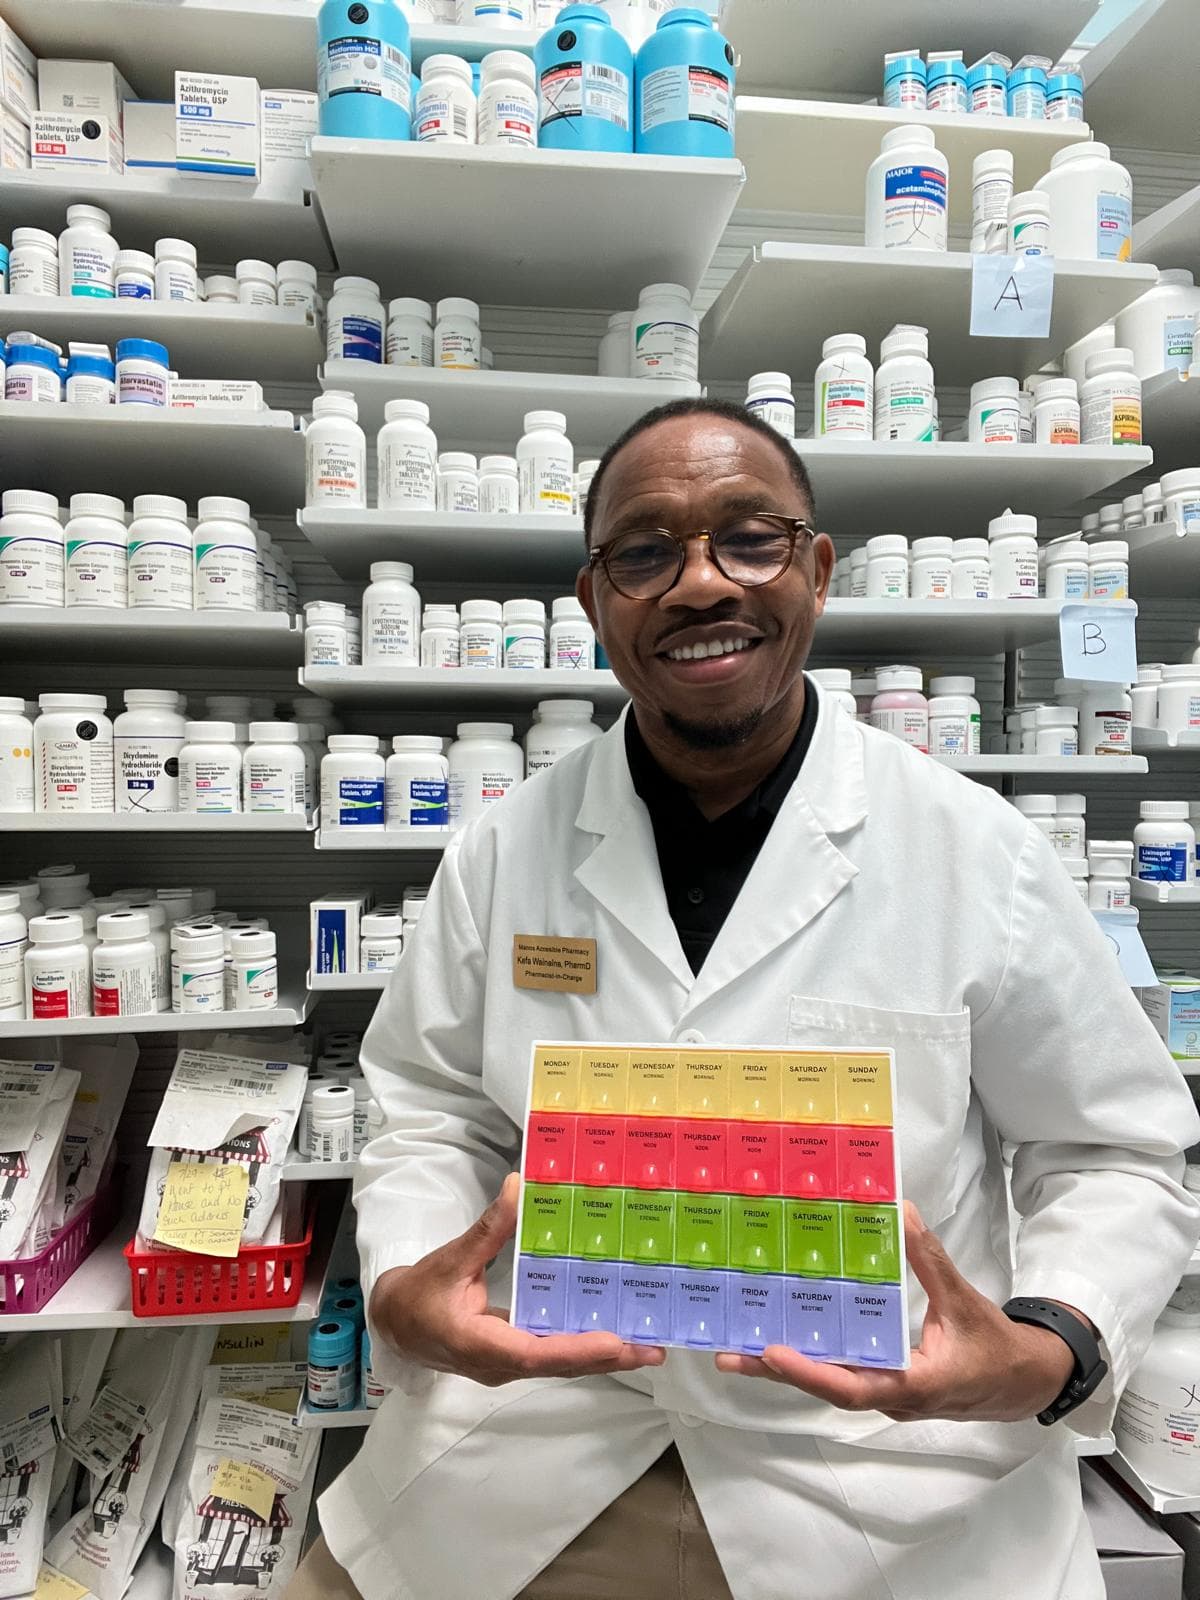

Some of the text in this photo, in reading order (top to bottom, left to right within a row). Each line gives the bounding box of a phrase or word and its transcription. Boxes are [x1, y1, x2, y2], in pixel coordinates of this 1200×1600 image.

[329, 46, 363, 55] Metformin
[180, 84, 229, 96] Azithromycin
[180, 94, 228, 105] Tablets, USP
[198, 108, 210, 116] mg
[35, 123, 81, 133] Azithromycin
[36, 133, 80, 142] Tablets, USP
[886, 167, 914, 179] MAJOR
[994, 276, 1023, 311] A
[120, 376, 163, 389] Atorvastatin
[318, 458, 356, 468] LEVOTHYROXINE
[327, 464, 347, 472] SODIUM
[1082, 623, 1106, 656] B
[123, 752, 158, 761] Dicyclomine
[121, 761, 162, 769] Hydrochloride
[122, 770, 144, 778] Tablets,
[562, 948, 589, 957] Pharmacy
[517, 956, 591, 970] Kefa Wainaina, PharmD
[525, 970, 582, 982] Pharmacist-in-Charge
[590, 1061, 619, 1069] TUESDAY
[686, 1063, 722, 1071] THURSDAY
[848, 1066, 878, 1074] SUNDAY
[537, 1126, 566, 1134] MONDAY
[585, 1128, 616, 1137] TUESDAY
[628, 1131, 672, 1139] WEDNESDAY
[683, 1133, 721, 1142] THURSDAY
[741, 1135, 767, 1143] FRIDAY
[789, 1138, 828, 1146] SATURDAY
[849, 1140, 880, 1148] SUNDAY
[534, 1197, 562, 1205] MONDAY
[582, 1200, 613, 1209] TUESDAY
[627, 1203, 671, 1213] WEDNESDAY
[684, 1206, 722, 1216] THURSDAY
[743, 1209, 770, 1218] FRIDAY
[792, 1213, 833, 1222] SATURDAY
[854, 1216, 886, 1225] SUNDAY
[527, 1271, 557, 1281] MONDAY
[577, 1276, 609, 1285] TUESDAY
[622, 1279, 670, 1289] WEDNESDAY
[680, 1283, 720, 1293] THURSDAY
[582, 1288, 602, 1296] BEDTIME
[741, 1287, 769, 1297] FRIDAY
[689, 1295, 711, 1303] BEDTIME
[791, 1292, 833, 1302] SATURDAY
[854, 1296, 887, 1306] SUNDAY
[744, 1300, 766, 1308] BEDTIME
[217, 1336, 264, 1350] NSULIN
[265, 1466, 299, 1492] pharmacy
